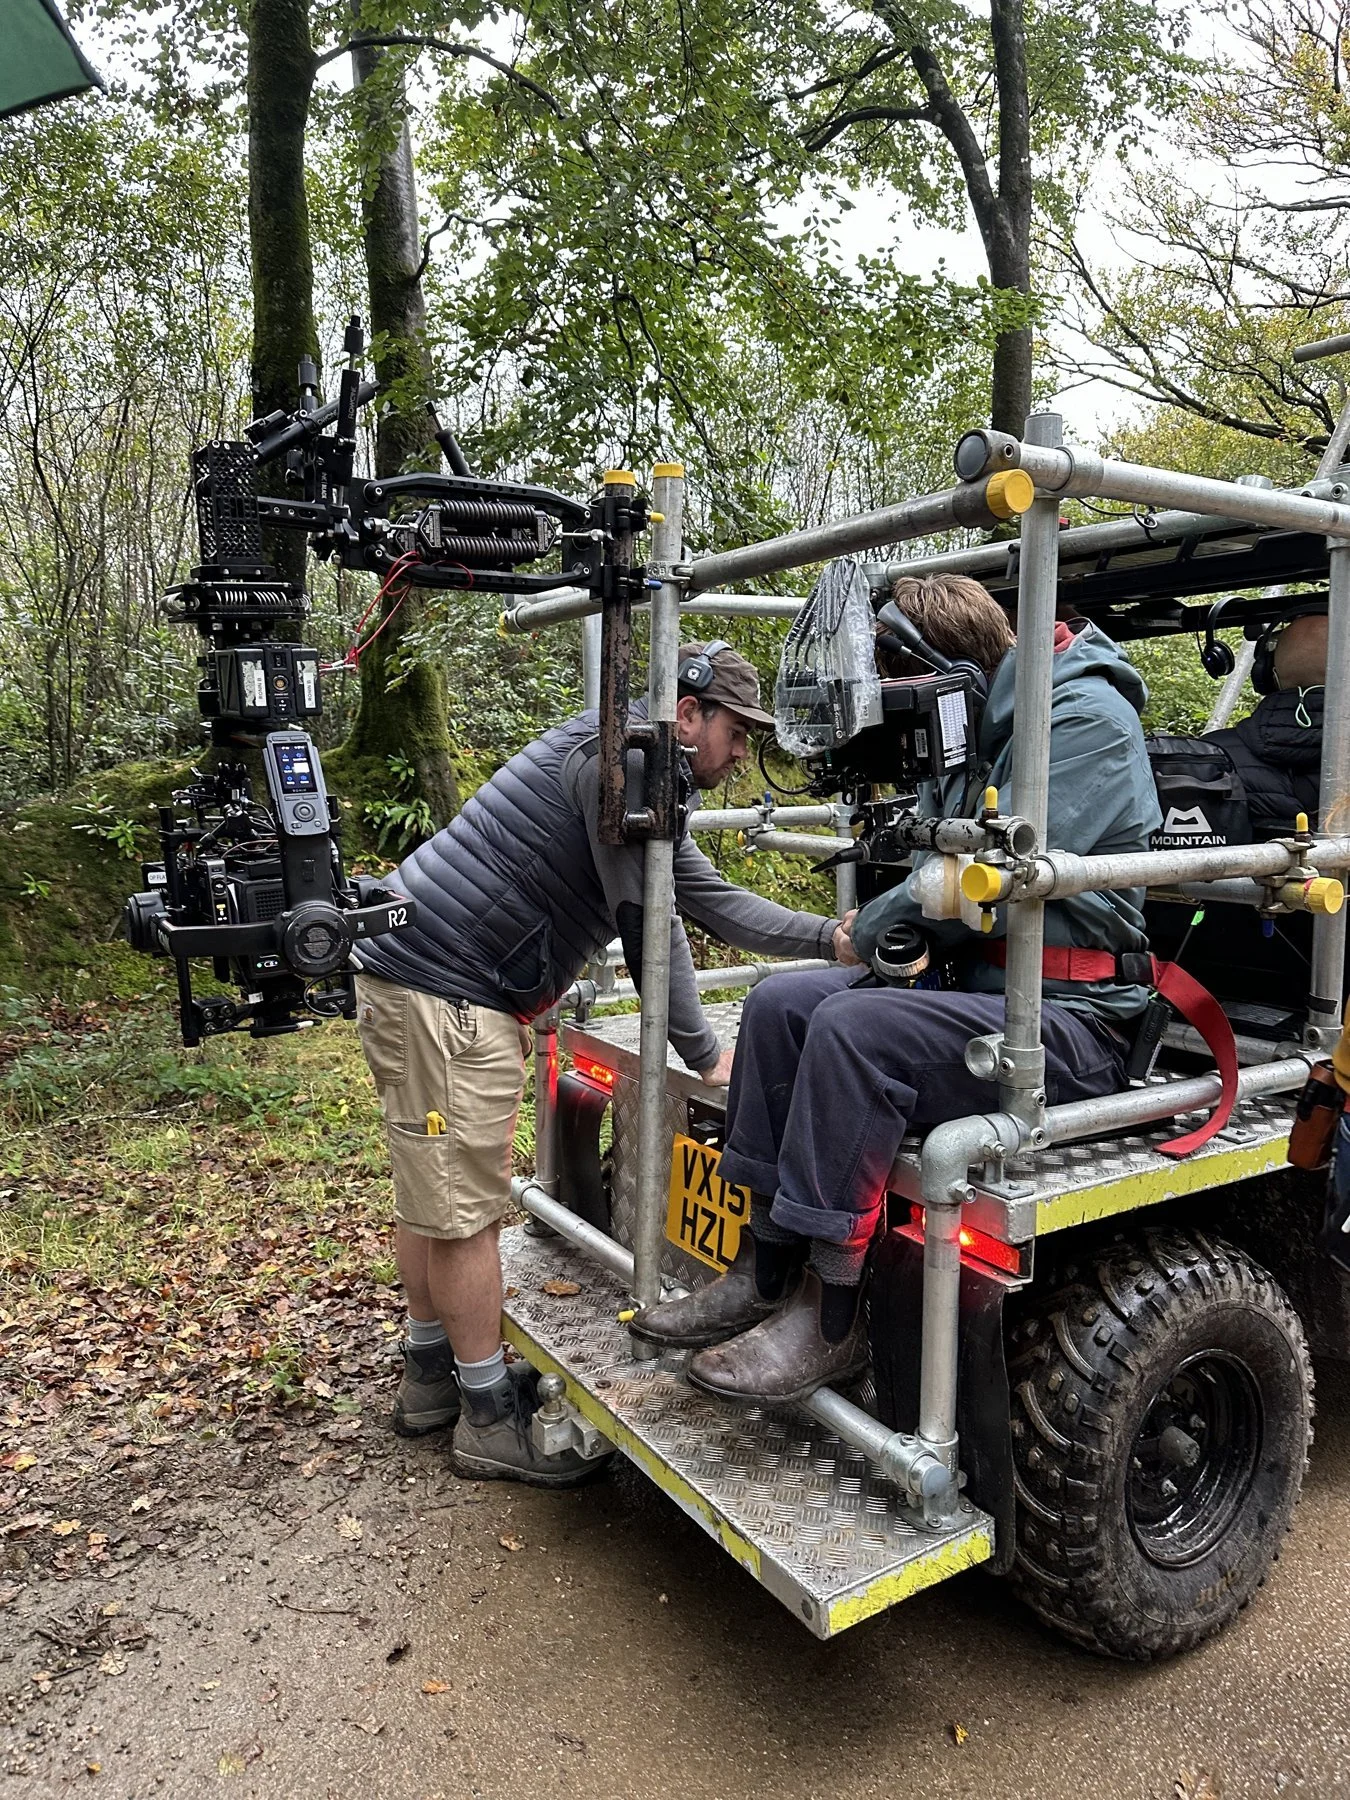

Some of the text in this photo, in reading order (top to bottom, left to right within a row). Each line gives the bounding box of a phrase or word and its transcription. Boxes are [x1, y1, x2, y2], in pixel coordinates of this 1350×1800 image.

[1151, 835, 1227, 845] MOUNTAIN
[387, 907, 408, 929] R2
[683, 1143, 746, 1217] VX15
[680, 1196, 734, 1268] HZL
